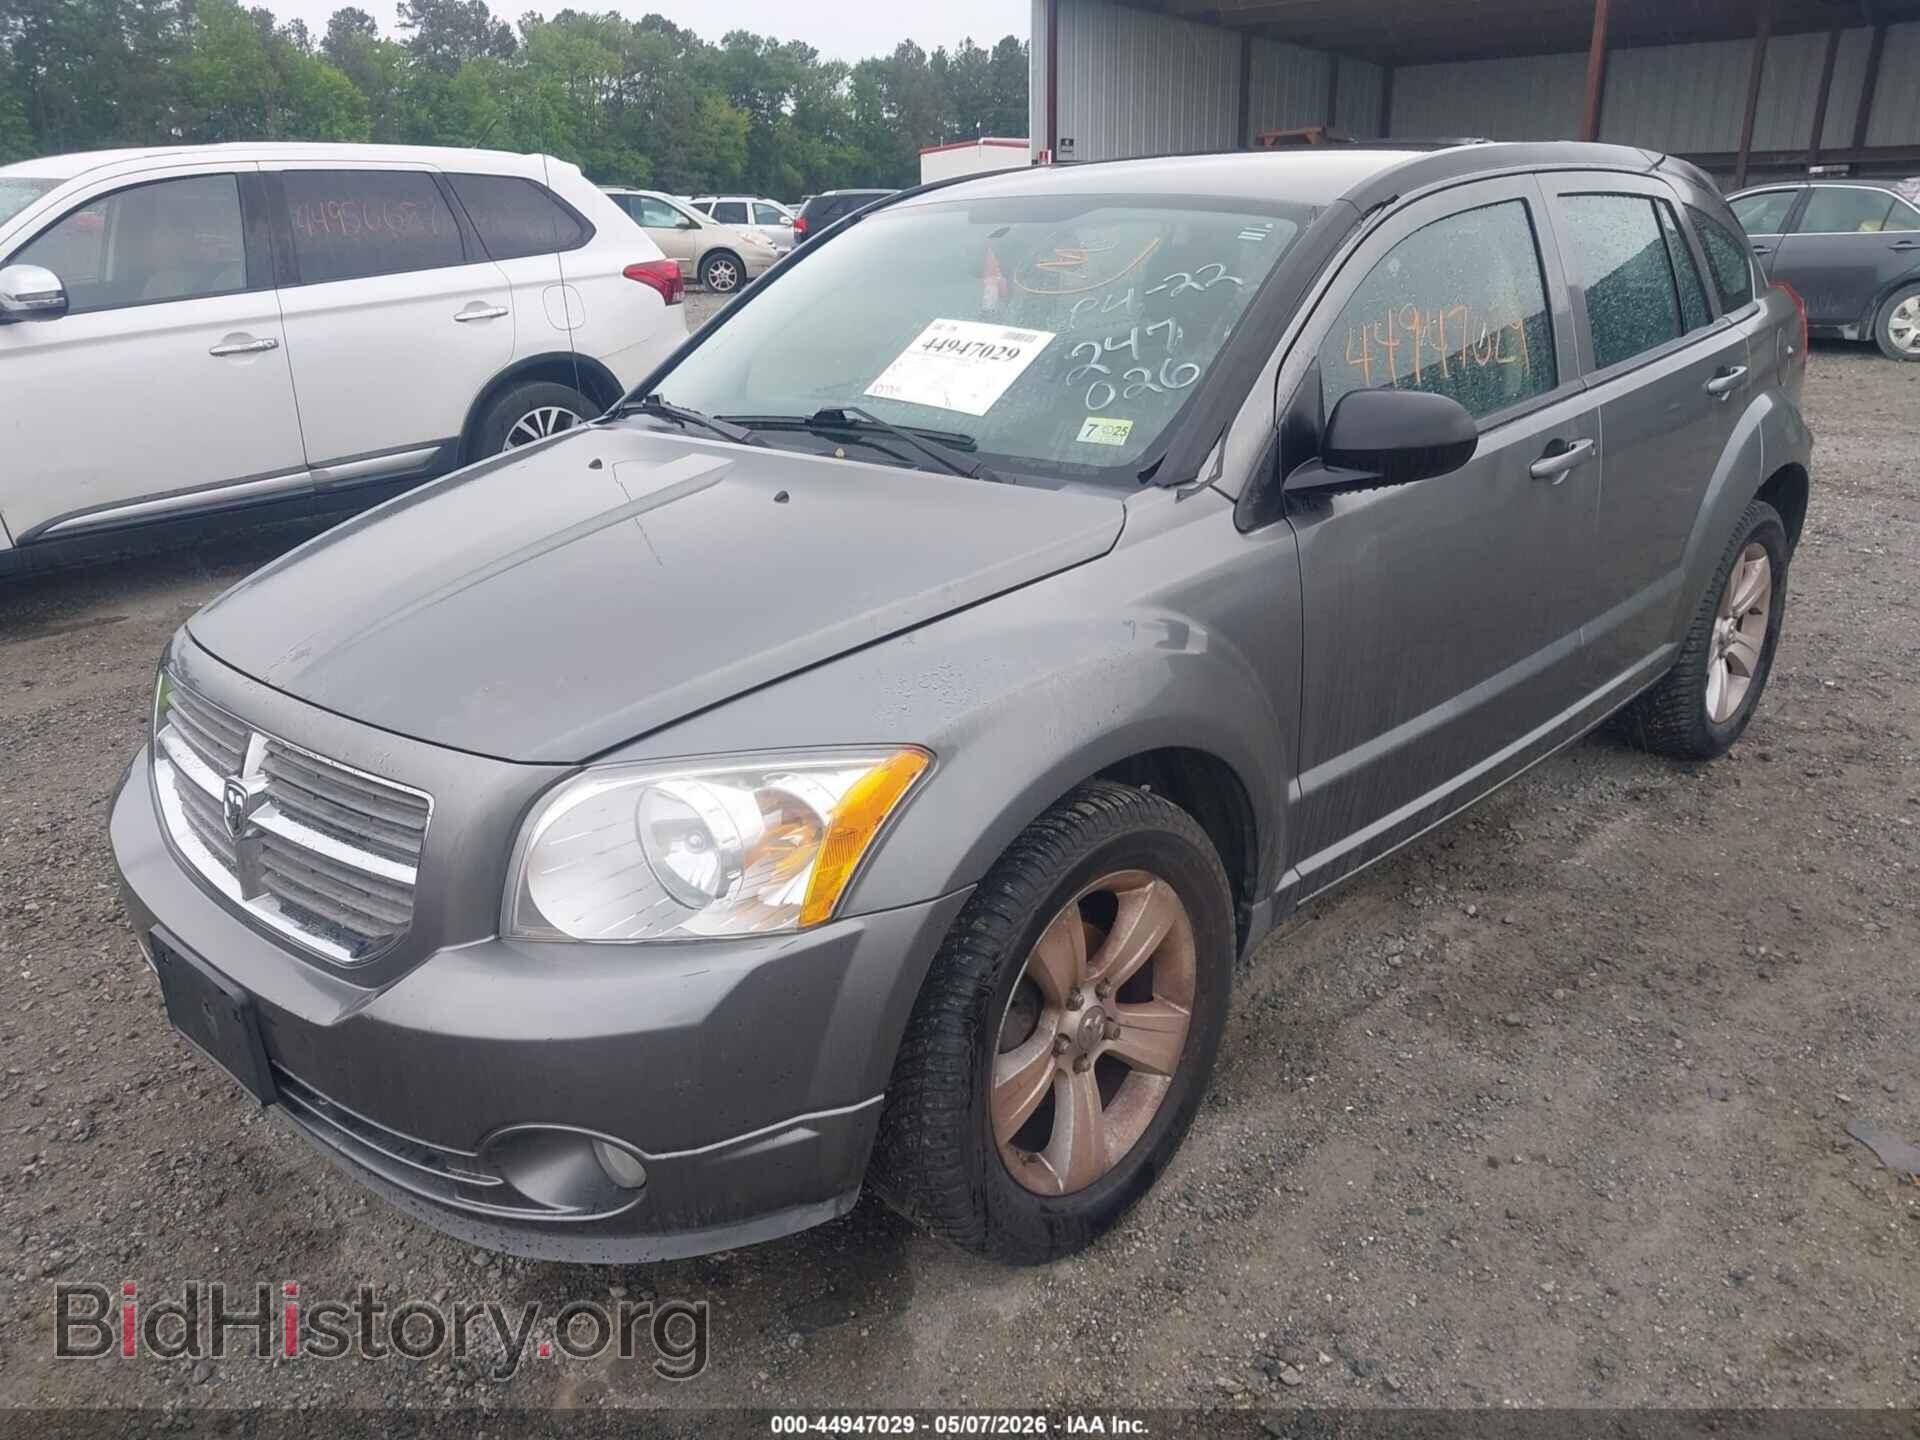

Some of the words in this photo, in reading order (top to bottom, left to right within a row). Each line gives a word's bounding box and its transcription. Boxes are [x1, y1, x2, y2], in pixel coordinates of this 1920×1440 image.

[921, 336, 1021, 362] 44947029
[1086, 358, 1200, 411] 026
[1086, 423, 1099, 438] 7
[1112, 425, 1129, 438] 25
